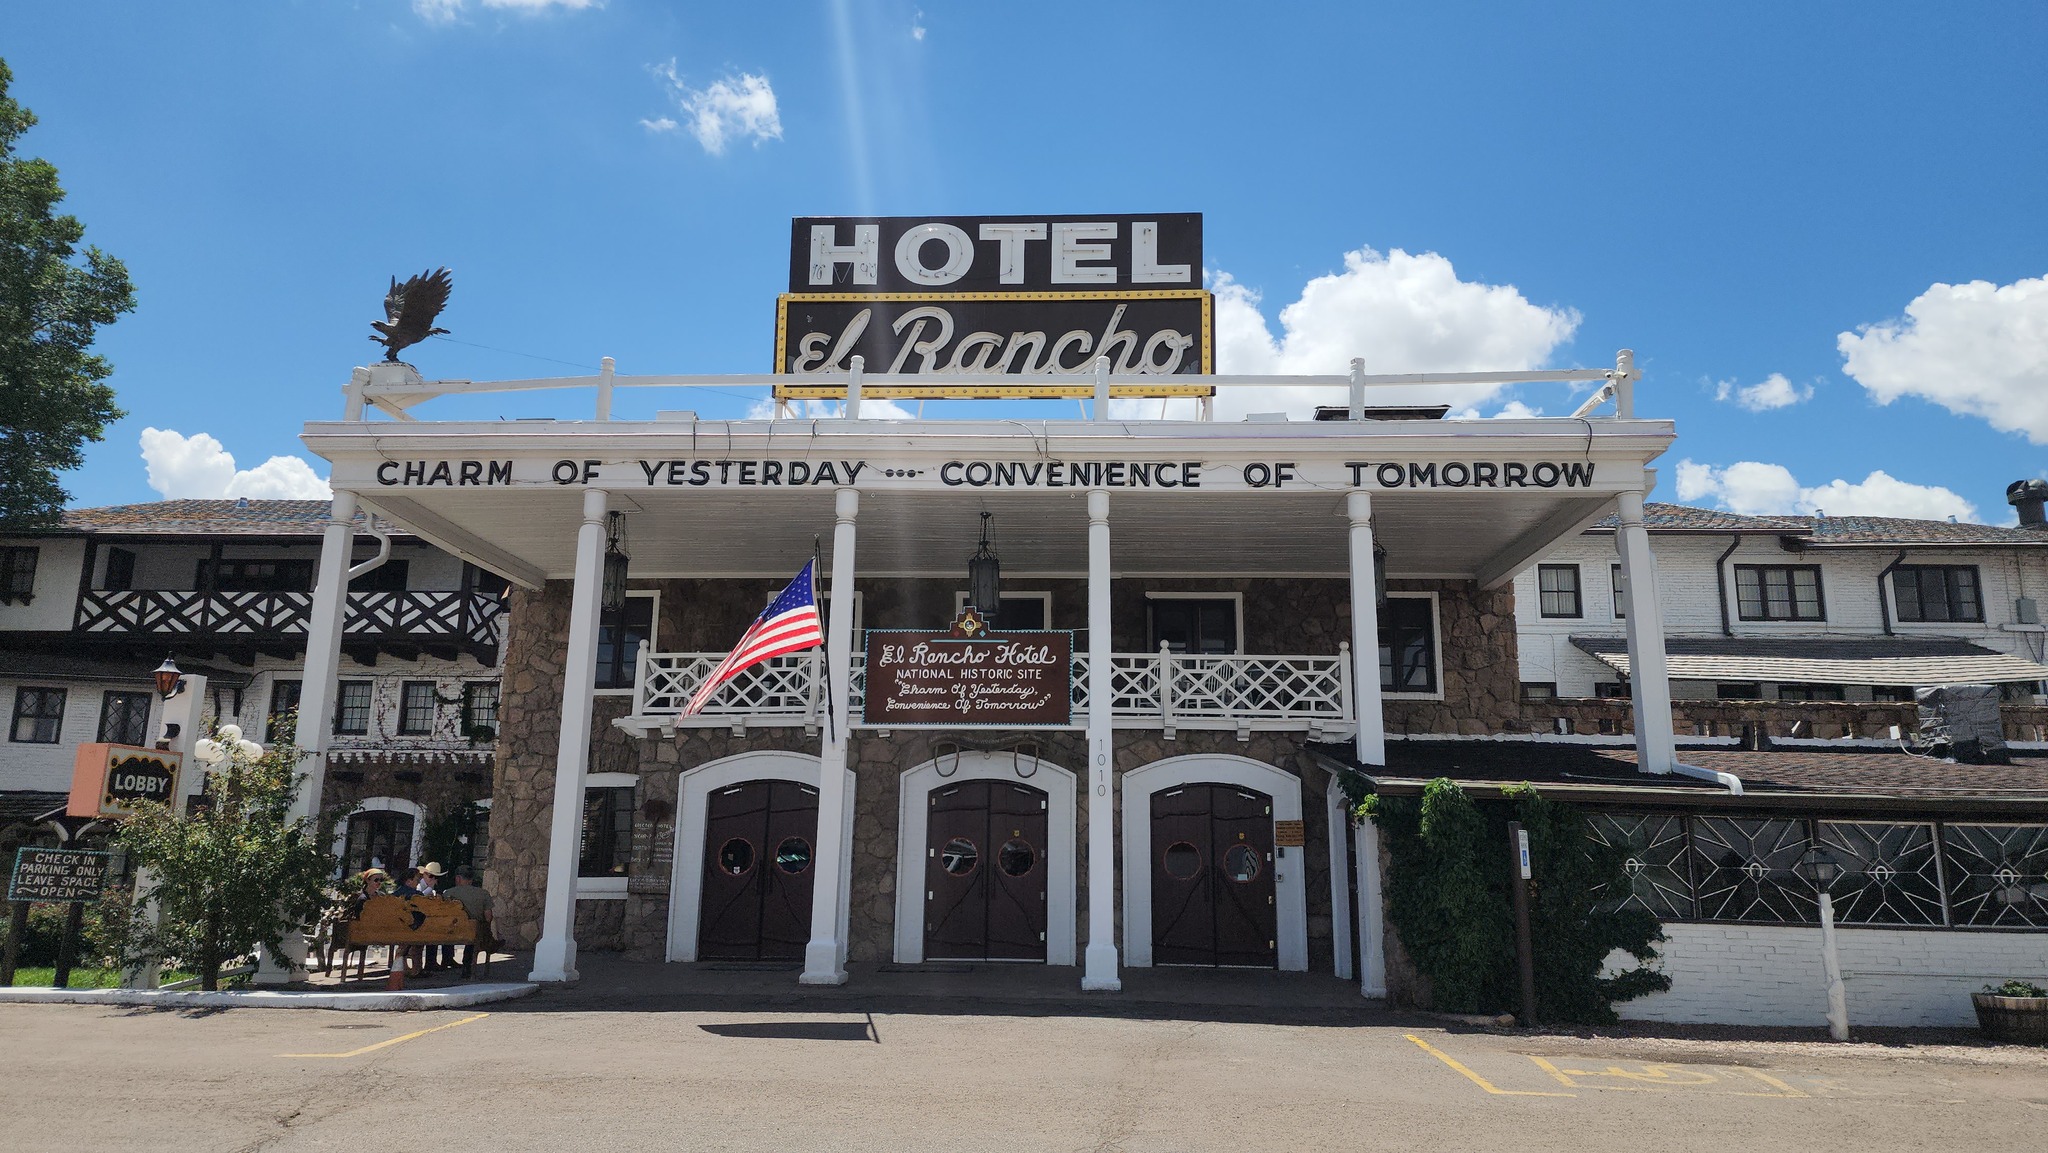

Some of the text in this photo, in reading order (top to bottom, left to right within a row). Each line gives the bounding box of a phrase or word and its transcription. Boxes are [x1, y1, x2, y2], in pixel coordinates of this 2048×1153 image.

[809, 221, 1191, 286] HOTEL
[887, 304, 1194, 375] Rancho
[377, 461, 513, 486] CHARM
[552, 460, 602, 485] OF
[639, 460, 866, 486] YESTERDAY
[940, 461, 1201, 487] CONVENIENCE
[1243, 462, 1296, 488] OF
[1344, 462, 1596, 488] TOMORROW
[879, 642, 1057, 667] El Rancho Hotel
[896, 668, 1042, 680] NATIONAL HISTORIC SITE
[951, 682, 966, 698] Of
[885, 697, 951, 712] Convenience
[955, 699, 971, 714] Of
[1097, 739, 1106, 796] 1010
[115, 774, 169, 792] LOBBY
[35, 853, 96, 866] CHECK IN
[20, 863, 105, 877] PARKING ONLY
[17, 874, 99, 887] LEAVE SPACE
[40, 886, 76, 898] OPEN
